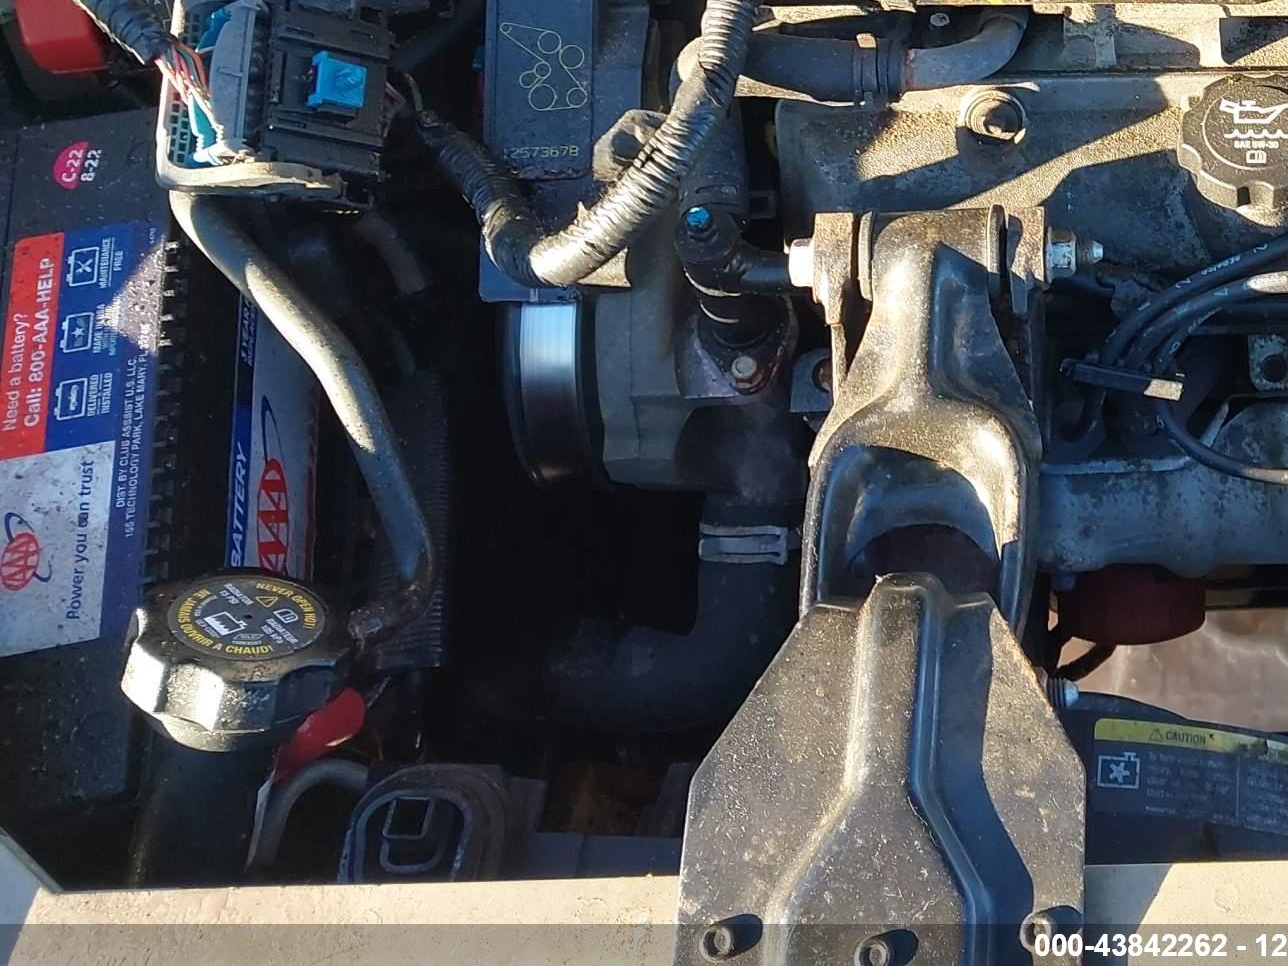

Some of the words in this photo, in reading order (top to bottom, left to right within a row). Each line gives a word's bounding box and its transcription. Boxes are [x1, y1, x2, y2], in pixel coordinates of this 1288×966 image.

[1233, 139, 1252, 150] SAE
[1251, 140, 1280, 150] 5W-30
[61, 149, 84, 183] C-22
[80, 149, 101, 182] 8-22
[98, 236, 112, 289] MAINTENANCE
[28, 256, 56, 383] 800-AAA-HELP
[8, 313, 31, 374] battery?
[10, 376, 21, 387] a
[87, 373, 100, 417] DELIVERED
[101, 371, 114, 415] INSTALLED
[2, 390, 21, 432] Need
[23, 386, 43, 428] Call:
[119, 439, 131, 468] CLUB
[125, 452, 141, 520] TECHNOLOGY
[134, 397, 145, 421] LAKE
[79, 459, 95, 497] trust
[117, 469, 128, 484] BY
[77, 501, 91, 528] can
[230, 441, 248, 568] BATTERY
[1, 534, 41, 589] AAA
[74, 533, 90, 565] you
[66, 567, 84, 621] Power
[176, 596, 198, 624] JAMAIS
[255, 582, 294, 598] NEVER
[291, 594, 316, 613] OPEN
[180, 622, 215, 648] OUVRIR
[224, 644, 274, 655] CHAUD!
[1165, 729, 1207, 746] CAUTION
